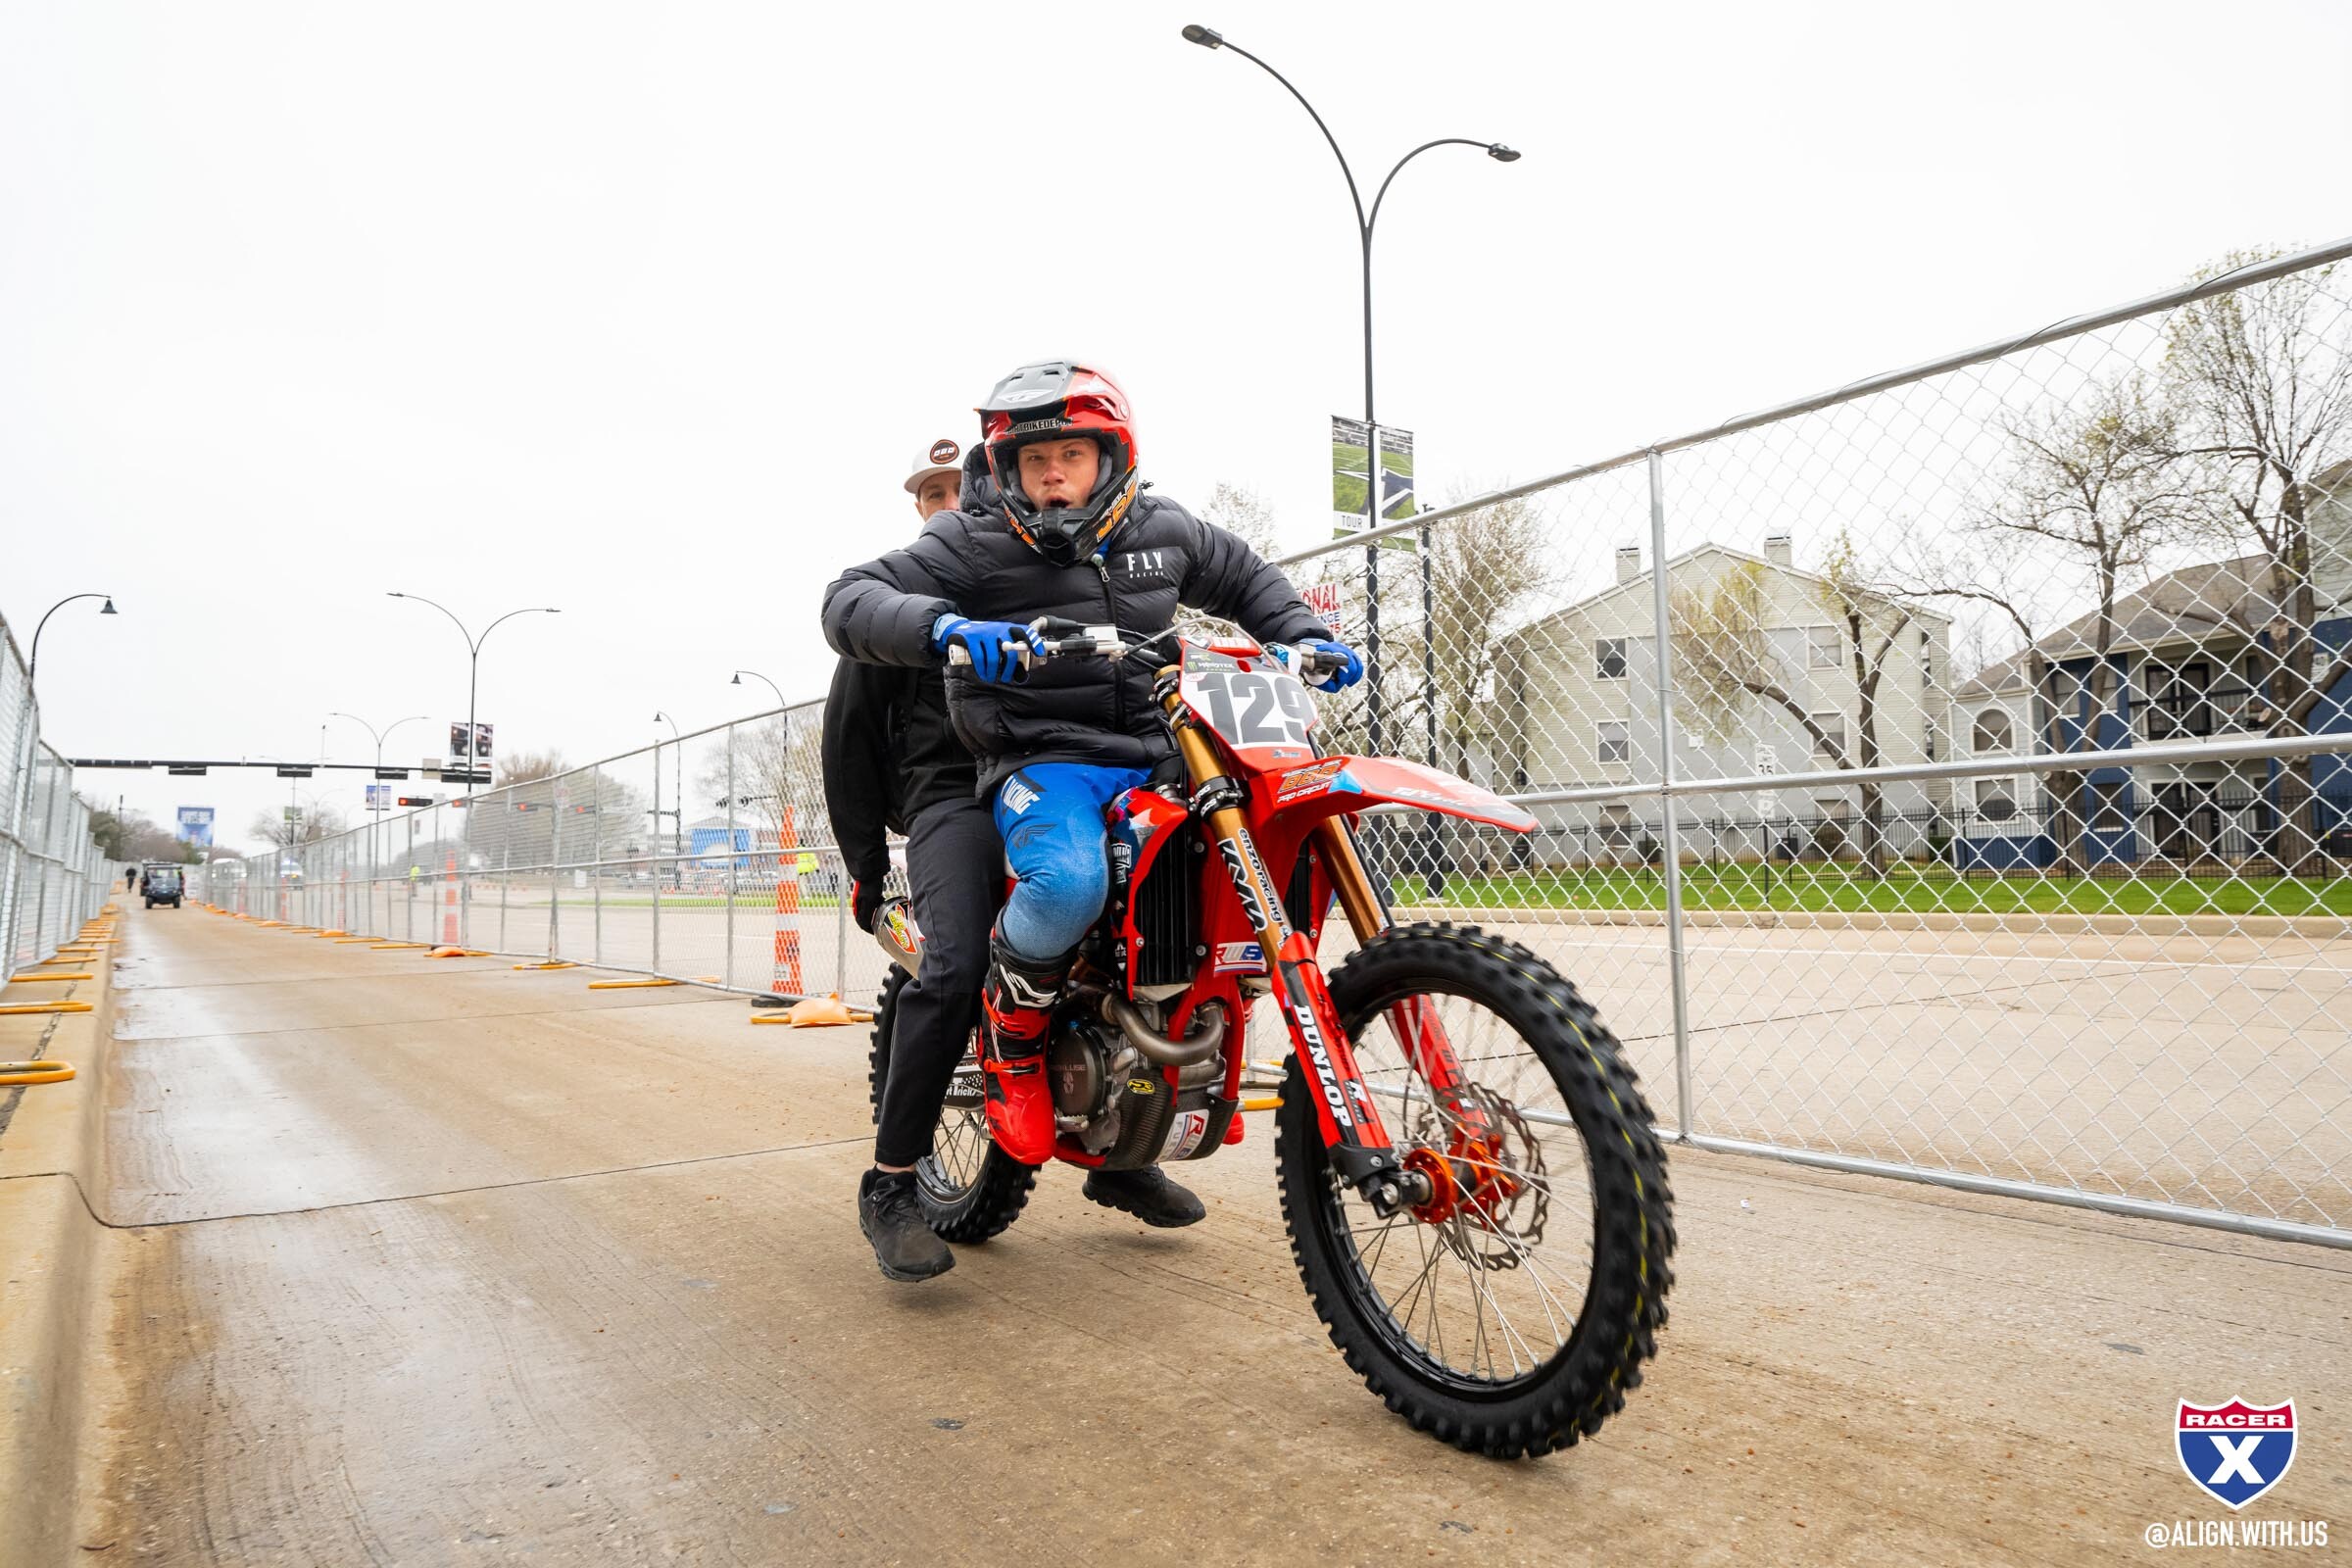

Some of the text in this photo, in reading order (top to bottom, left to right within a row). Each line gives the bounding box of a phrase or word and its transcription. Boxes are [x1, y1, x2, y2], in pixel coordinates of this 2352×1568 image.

[1341, 515, 1363, 528] TOUR
[1126, 551, 1163, 571] FLY
[1197, 673, 1316, 745] 129
[1277, 781, 1332, 804] PRO CIRCUIT
[1238, 828, 1284, 923] enzo racing
[1294, 1004, 1352, 1127] DUNLOP
